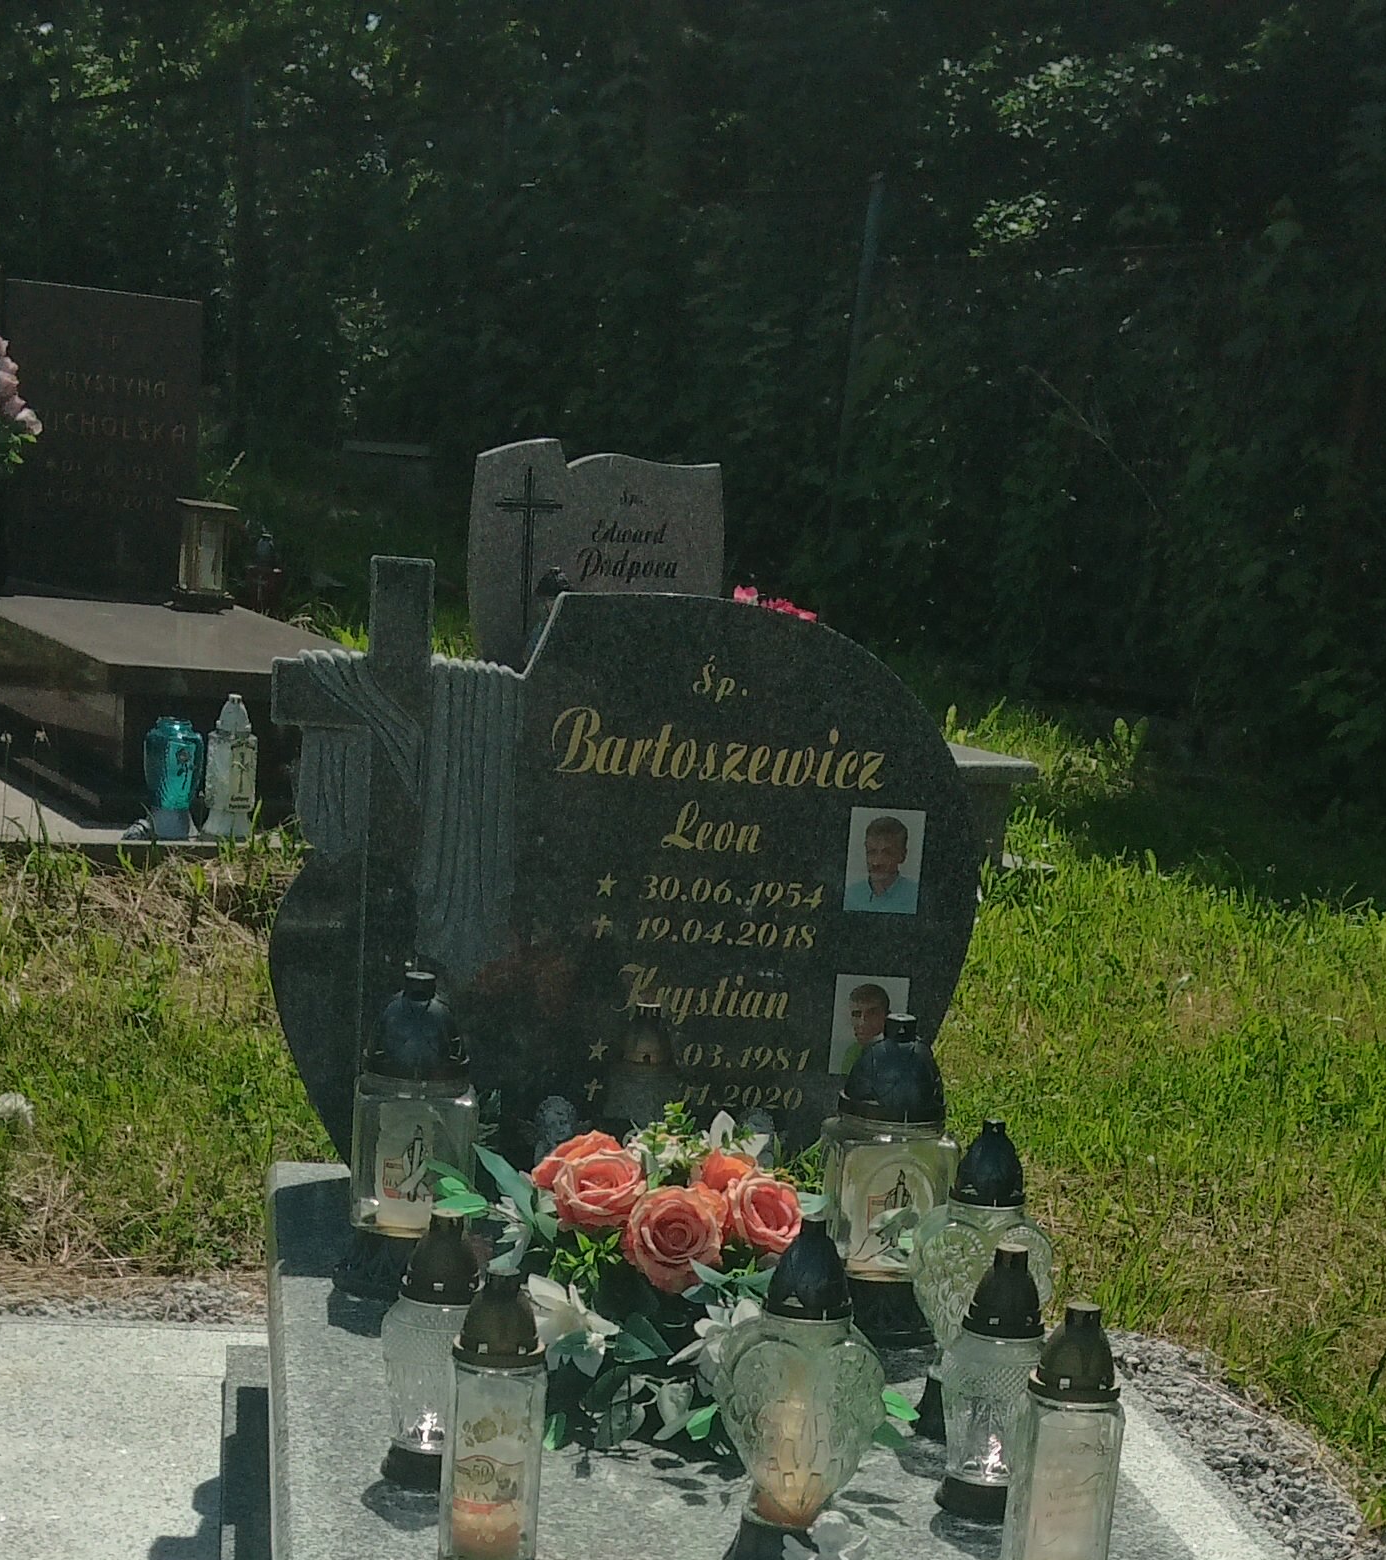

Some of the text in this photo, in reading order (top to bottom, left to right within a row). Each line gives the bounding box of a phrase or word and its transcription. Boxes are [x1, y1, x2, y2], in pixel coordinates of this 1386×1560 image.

[48, 369, 167, 399] KRYSTYNA
[592, 518, 668, 545] Edward
[576, 546, 678, 584] Podpora
[692, 654, 750, 703] Śp.
[551, 705, 886, 791] Bartoszewicz
[660, 799, 764, 854] Leon
[639, 873, 826, 911] 30.06.1954
[636, 915, 819, 950] 19.04.2018
[610, 962, 791, 1026] Krystian
[675, 1042, 812, 1073] .03.1981
